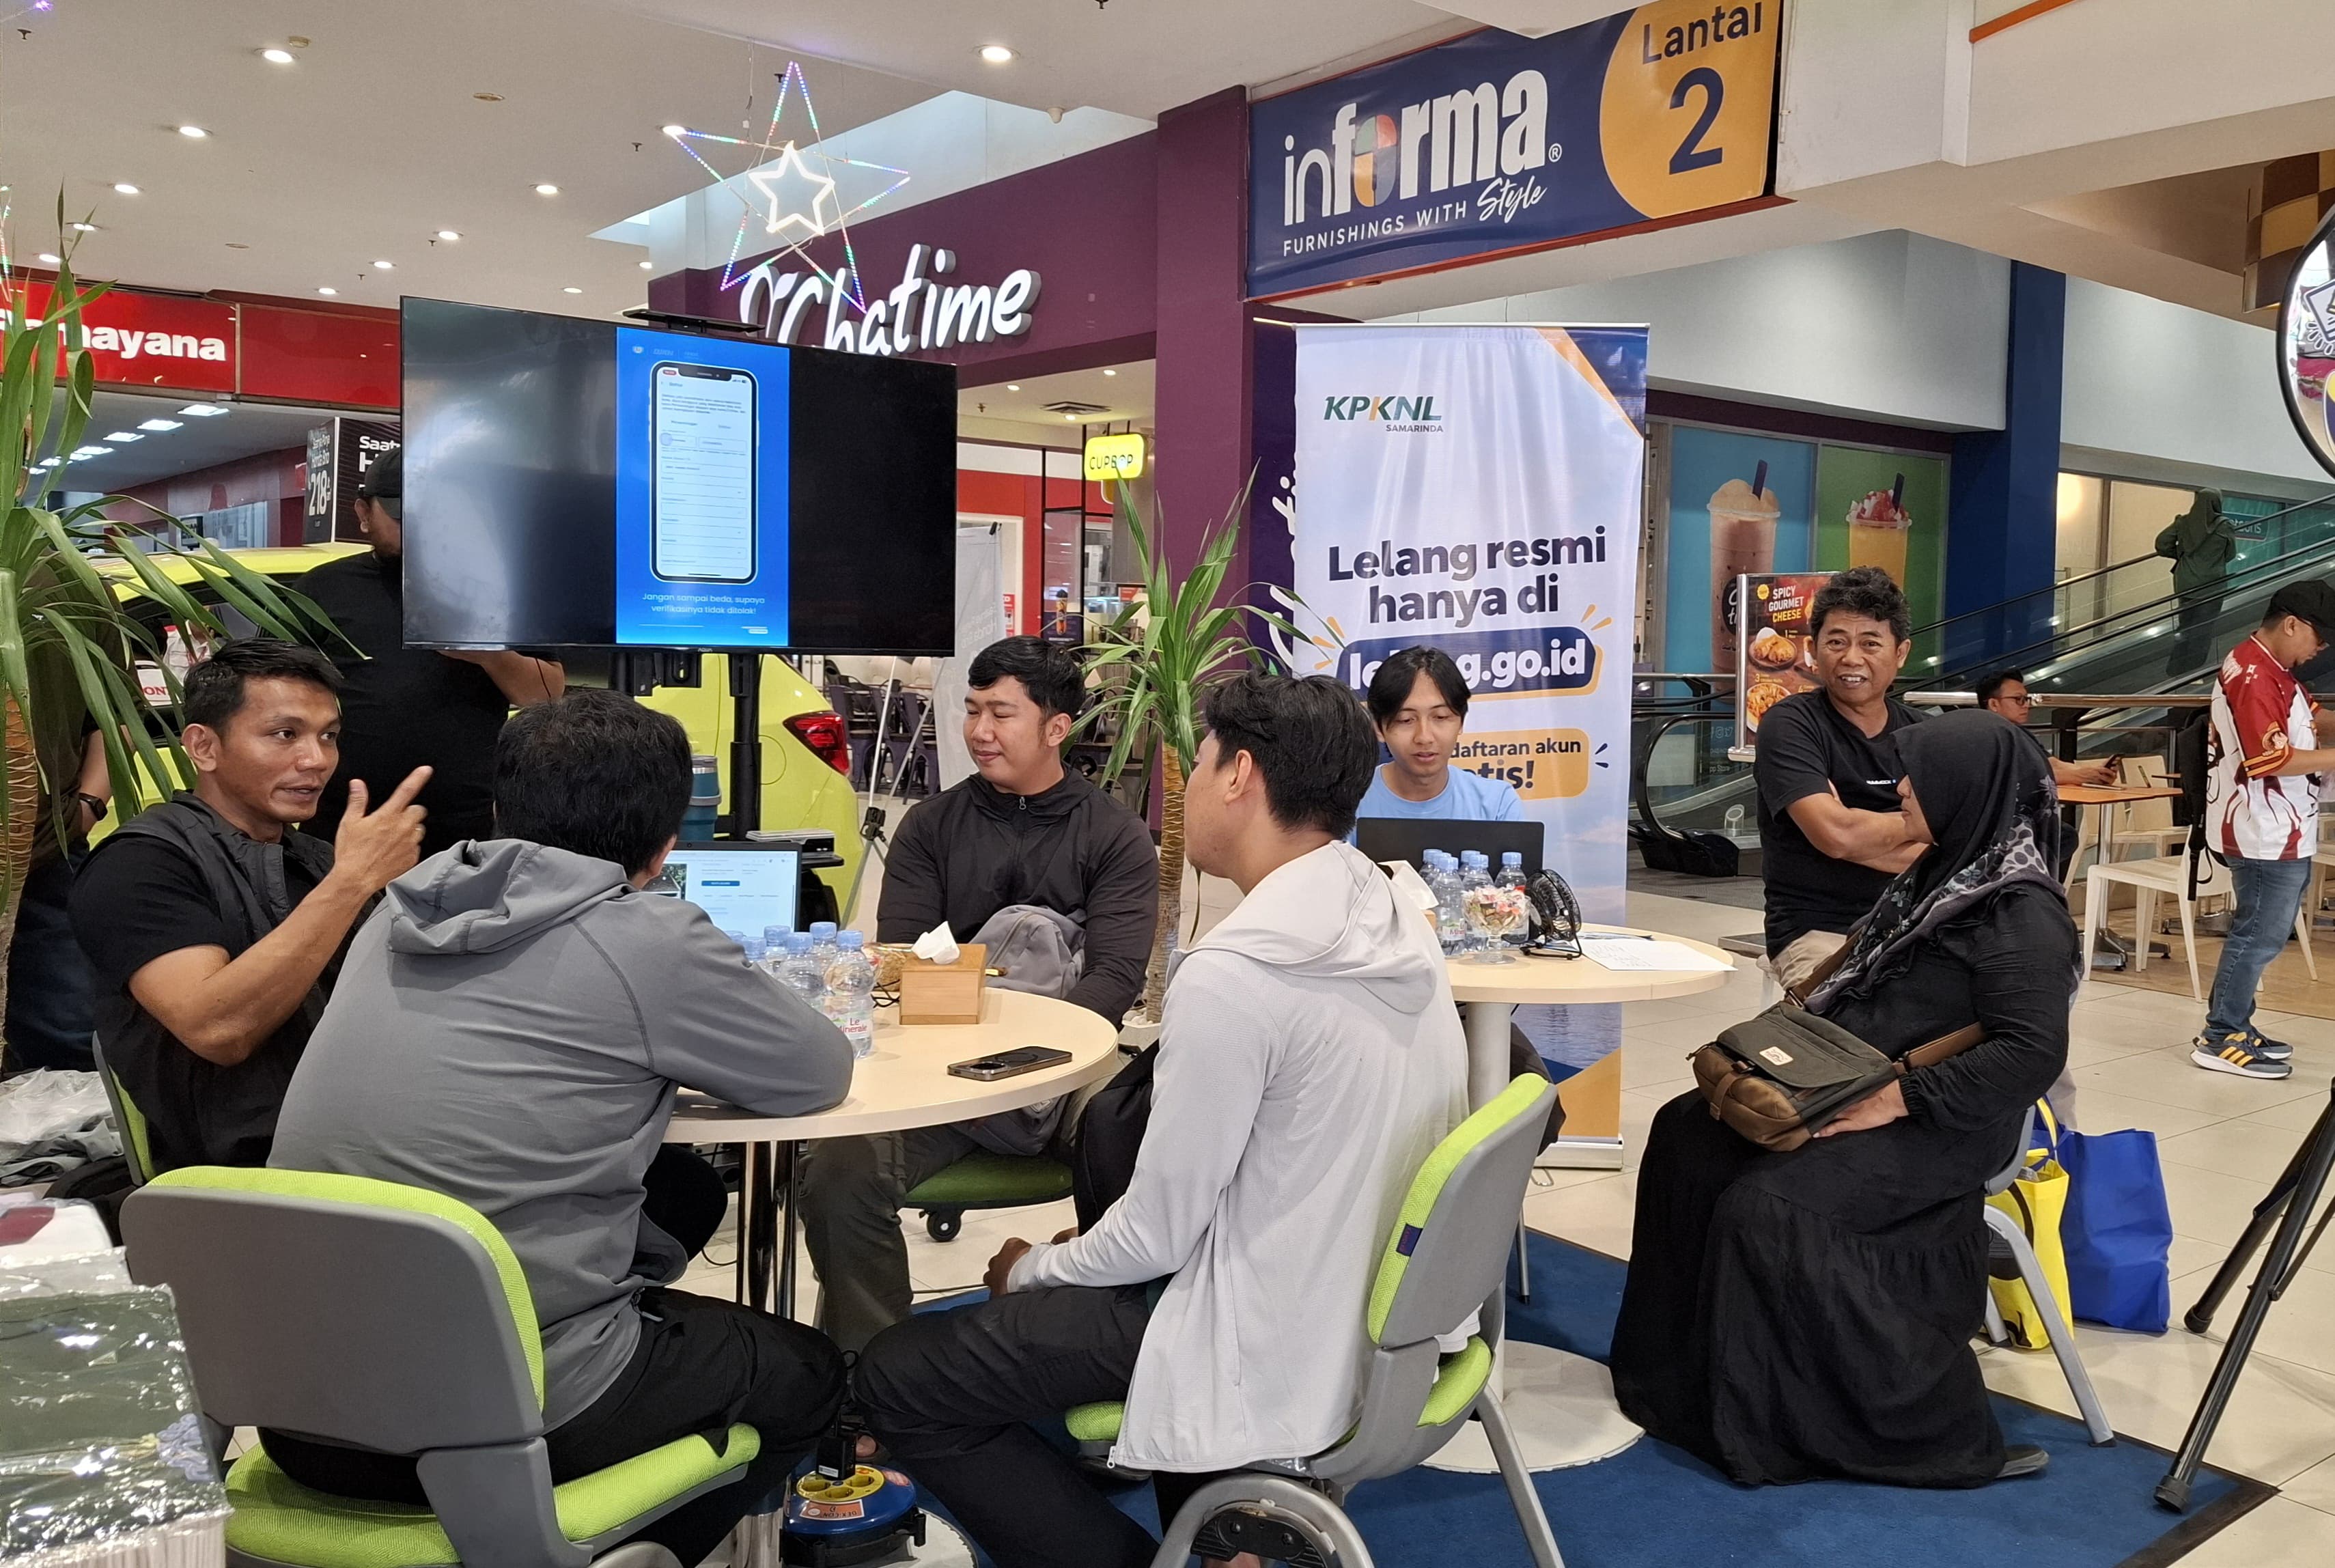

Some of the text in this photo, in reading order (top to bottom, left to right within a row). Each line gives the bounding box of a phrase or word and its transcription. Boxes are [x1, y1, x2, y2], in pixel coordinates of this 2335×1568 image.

[1642, 2, 1762, 64] Lantai
[1668, 66, 1724, 176] 2
[1284, 70, 1548, 227] informa
[1283, 175, 1548, 257] FURNISHINGS WITH Style
[1324, 395, 1442, 421] KPKNL
[1385, 424, 1444, 433] SAMARINDA
[1089, 453, 1134, 471] CUPBOP
[309, 470, 327, 516] 218
[1328, 525, 1606, 581] Lelang resmi
[642, 593, 766, 605] Jangan sampai beda, supaya
[1369, 573, 1559, 628] hanya di
[1772, 585, 1797, 600] SPICY
[651, 604, 757, 615] verifikasinya tidak ditolak!
[1768, 596, 1805, 612] GOURMET
[1772, 608, 1802, 623] CHEESE
[1349, 639, 1586, 690] leg.go.id
[1535, 738, 1582, 755] akun
[850, 1018, 860, 1026] Le
